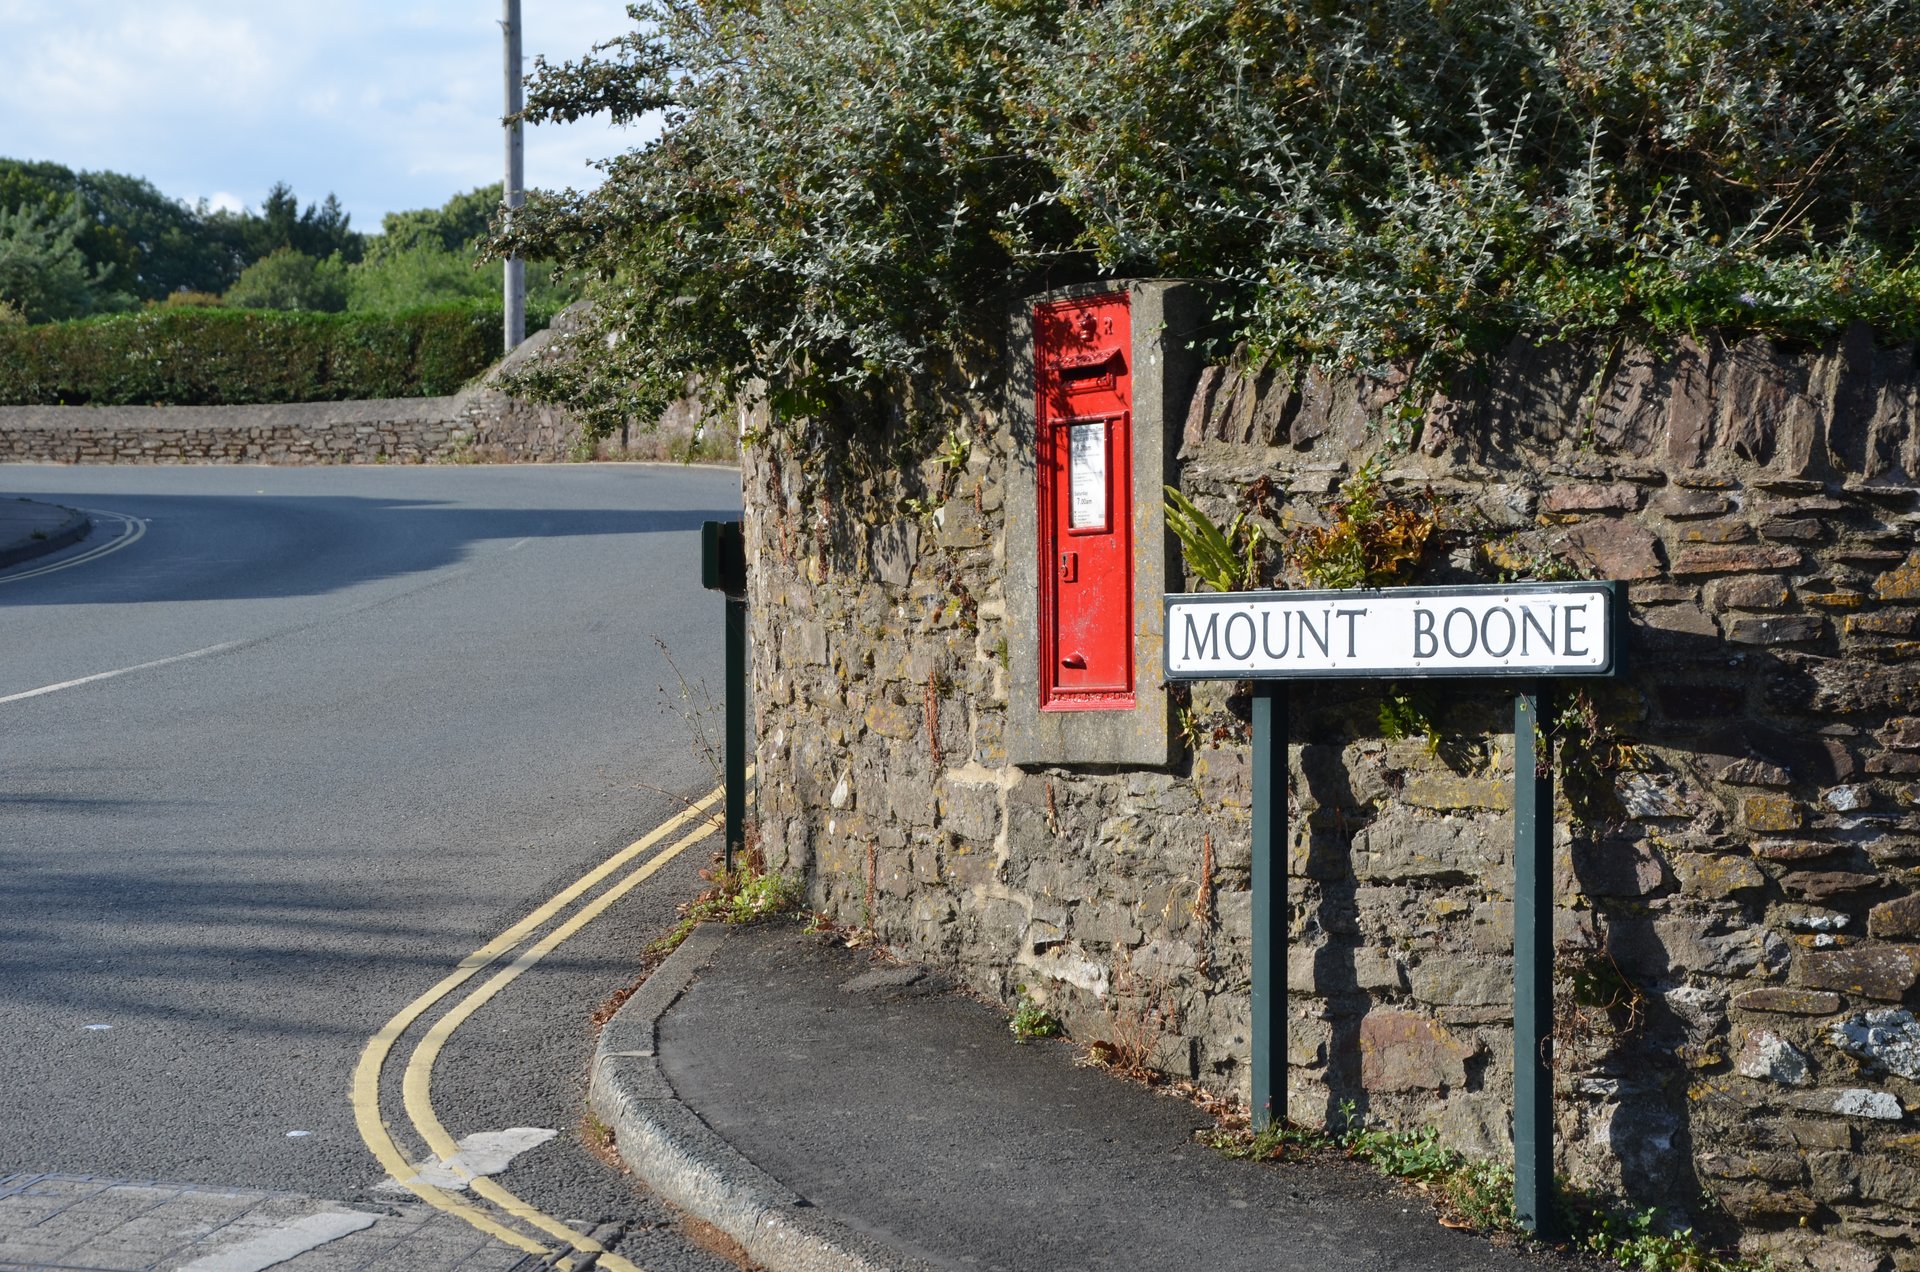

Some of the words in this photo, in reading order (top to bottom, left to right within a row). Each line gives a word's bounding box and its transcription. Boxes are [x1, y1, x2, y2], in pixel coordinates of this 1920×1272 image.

[1076, 497, 1092, 505] 7.00am
[1182, 608, 1368, 660] MOUNT
[1412, 604, 1589, 659] BOONE
